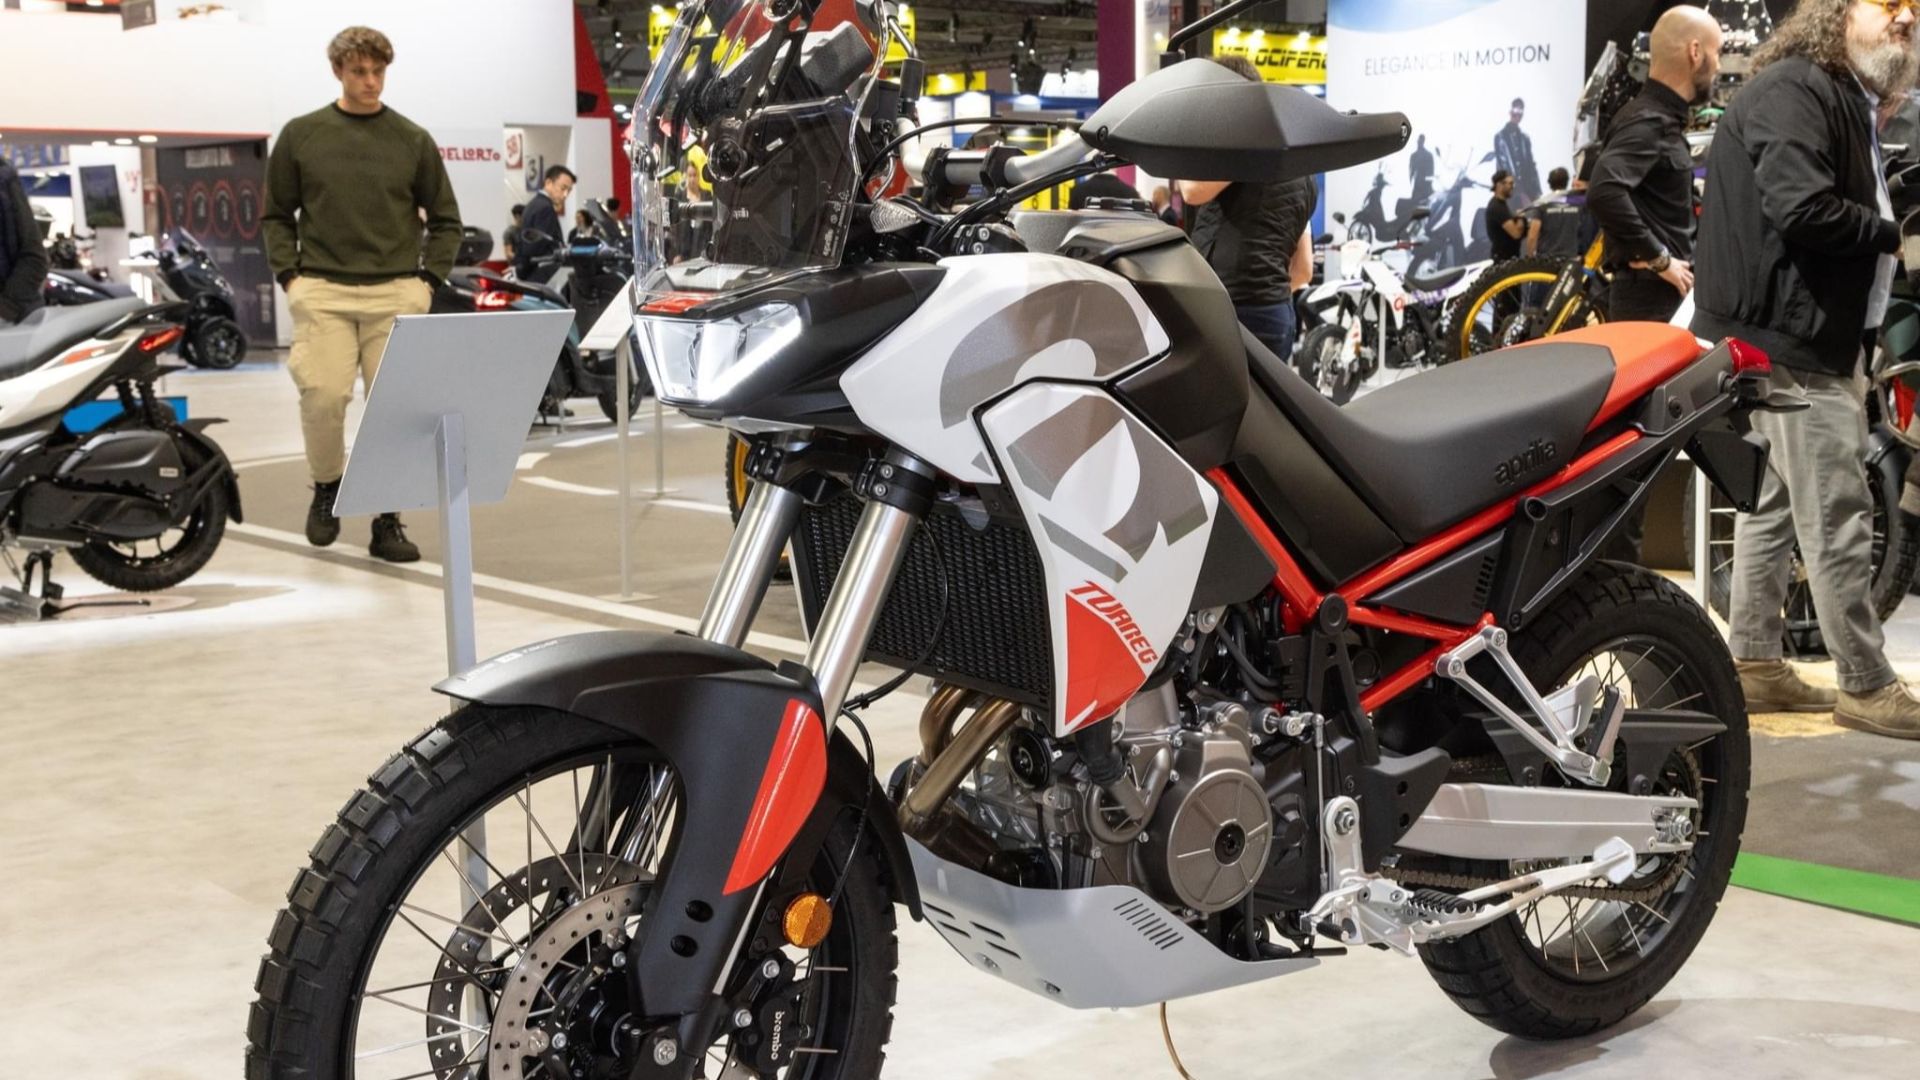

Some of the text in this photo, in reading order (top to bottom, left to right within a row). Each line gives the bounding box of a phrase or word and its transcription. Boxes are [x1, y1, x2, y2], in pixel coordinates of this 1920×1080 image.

[1364, 43, 1551, 77] ELEGANCE IN MOTION
[1495, 438, 1556, 484] aprilia
[1070, 580, 1158, 664] TUAREG
[771, 1010, 785, 1060] brembo
